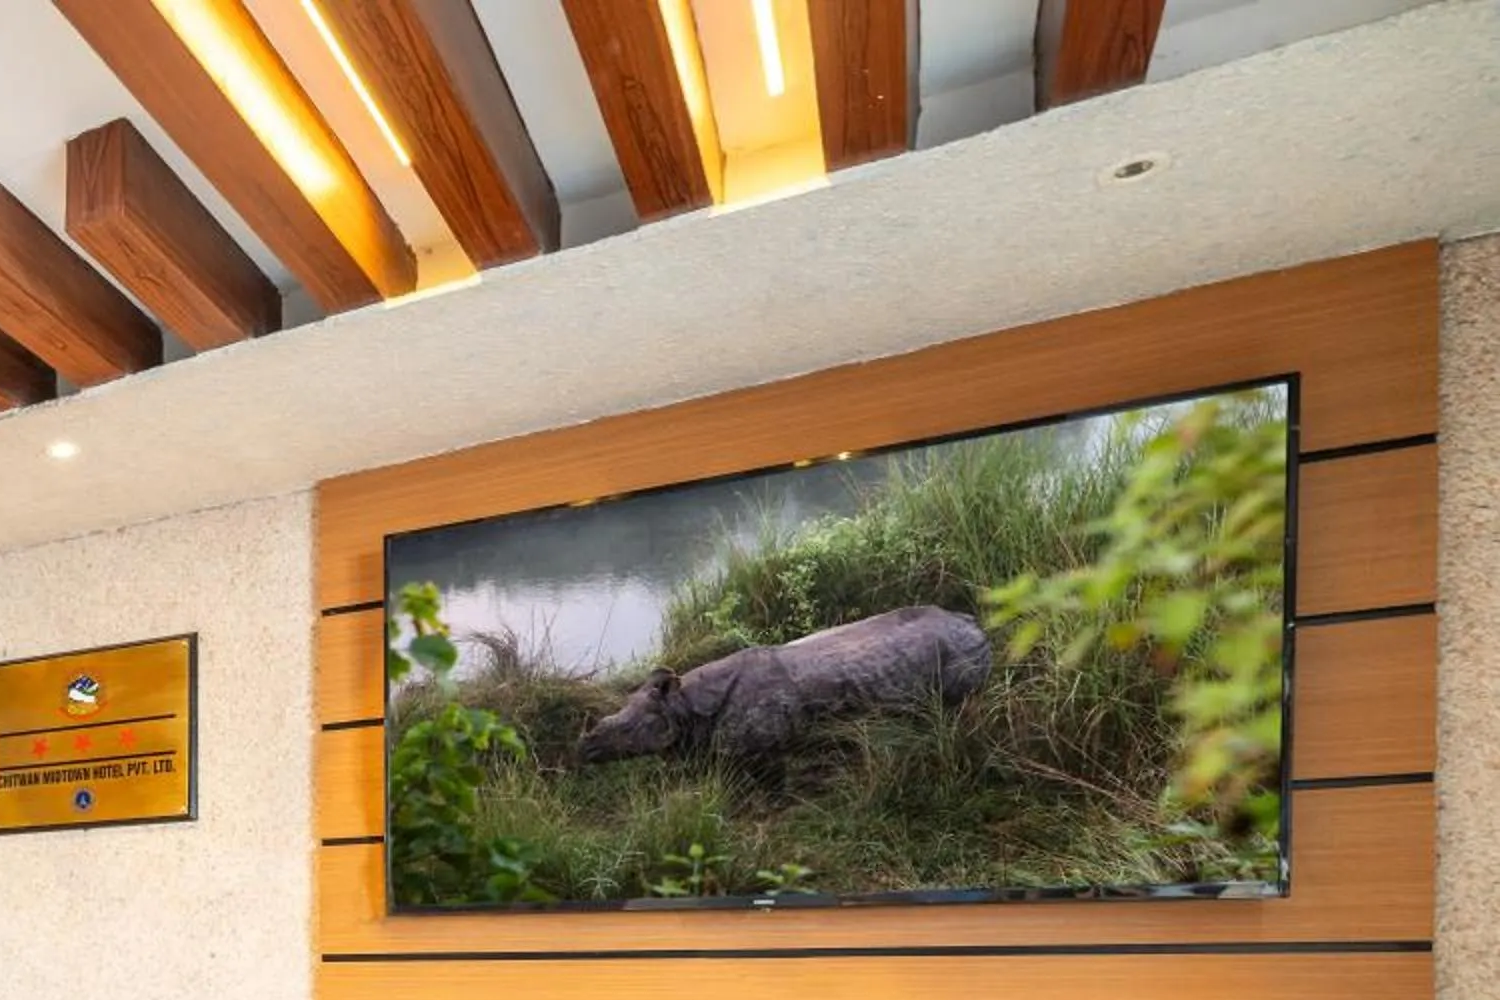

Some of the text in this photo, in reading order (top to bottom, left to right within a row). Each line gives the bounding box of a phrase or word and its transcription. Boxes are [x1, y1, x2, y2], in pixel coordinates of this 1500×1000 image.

[42, 767, 90, 785] MIDTOWN
[92, 764, 124, 781] HOTEL
[127, 761, 148, 777] PVT.
[153, 758, 177, 774] LTD.
